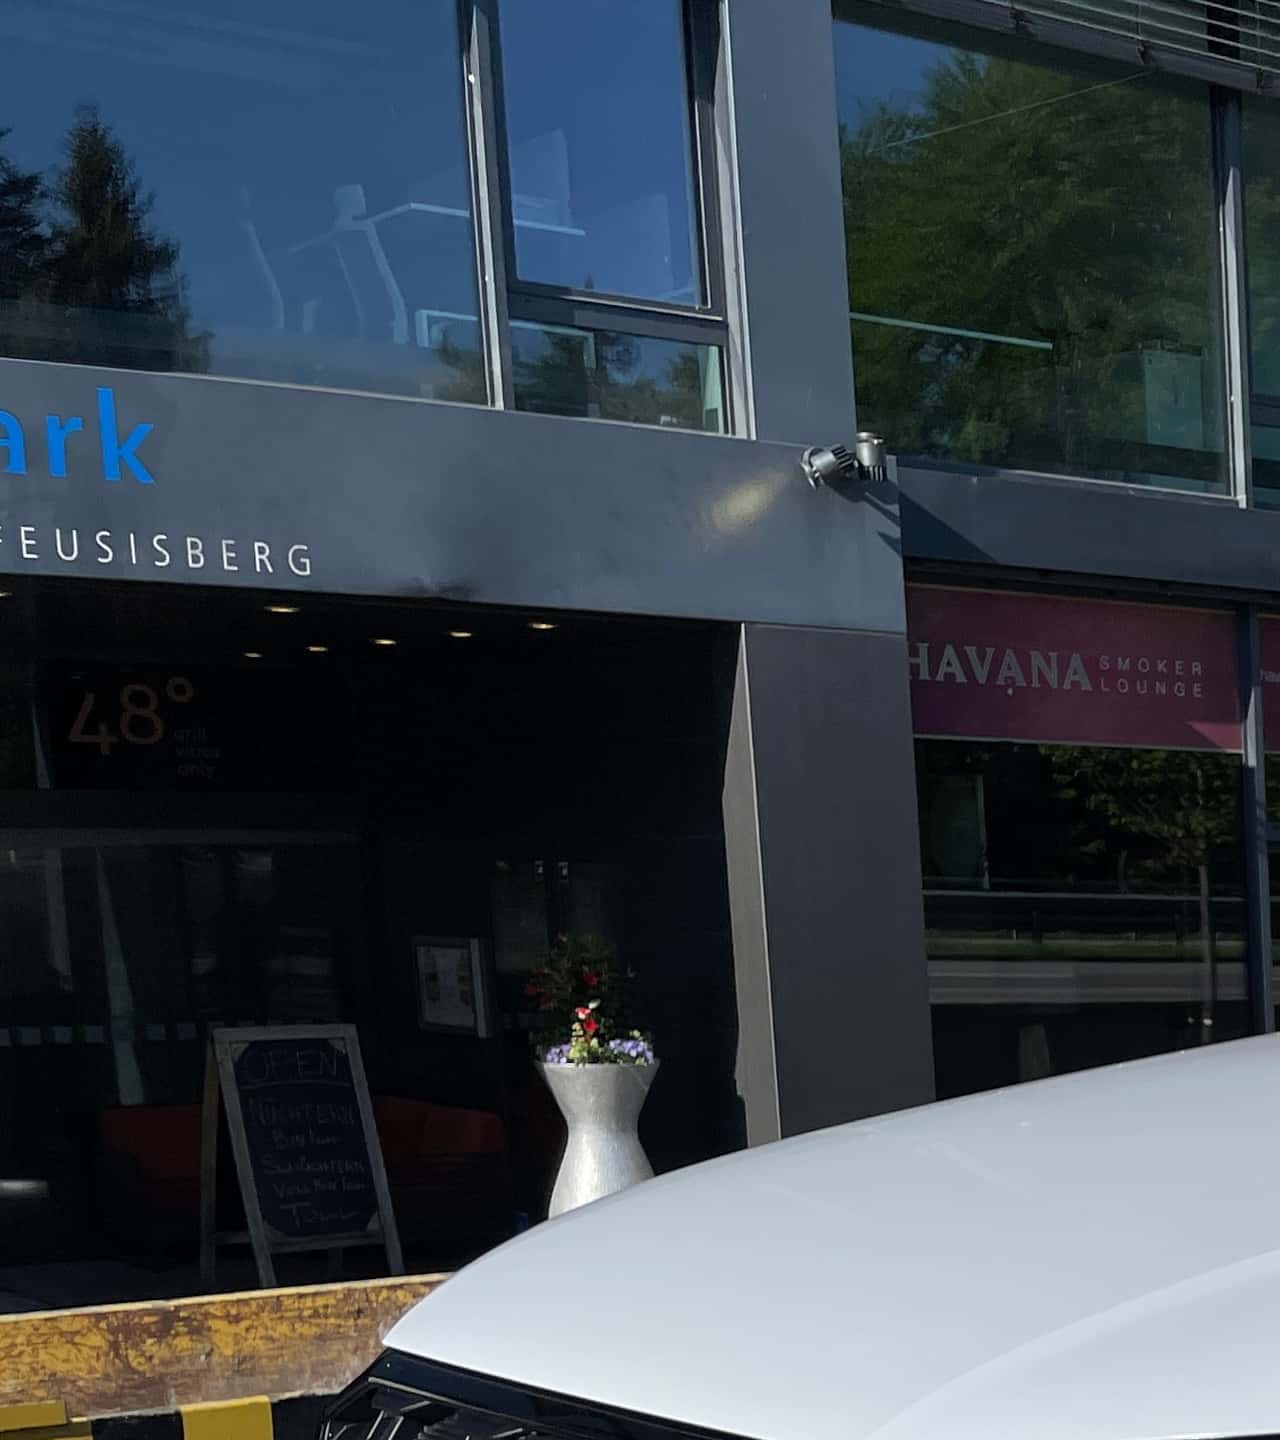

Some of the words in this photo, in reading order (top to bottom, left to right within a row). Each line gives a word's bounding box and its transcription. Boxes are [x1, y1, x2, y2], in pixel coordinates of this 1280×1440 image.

[0, 386, 155, 484] ark
[0, 525, 312, 577] EUSISBERG
[909, 641, 1093, 690] HAVANA
[1099, 655, 1203, 676] SMOKER
[1099, 677, 1204, 698] LOUNGE
